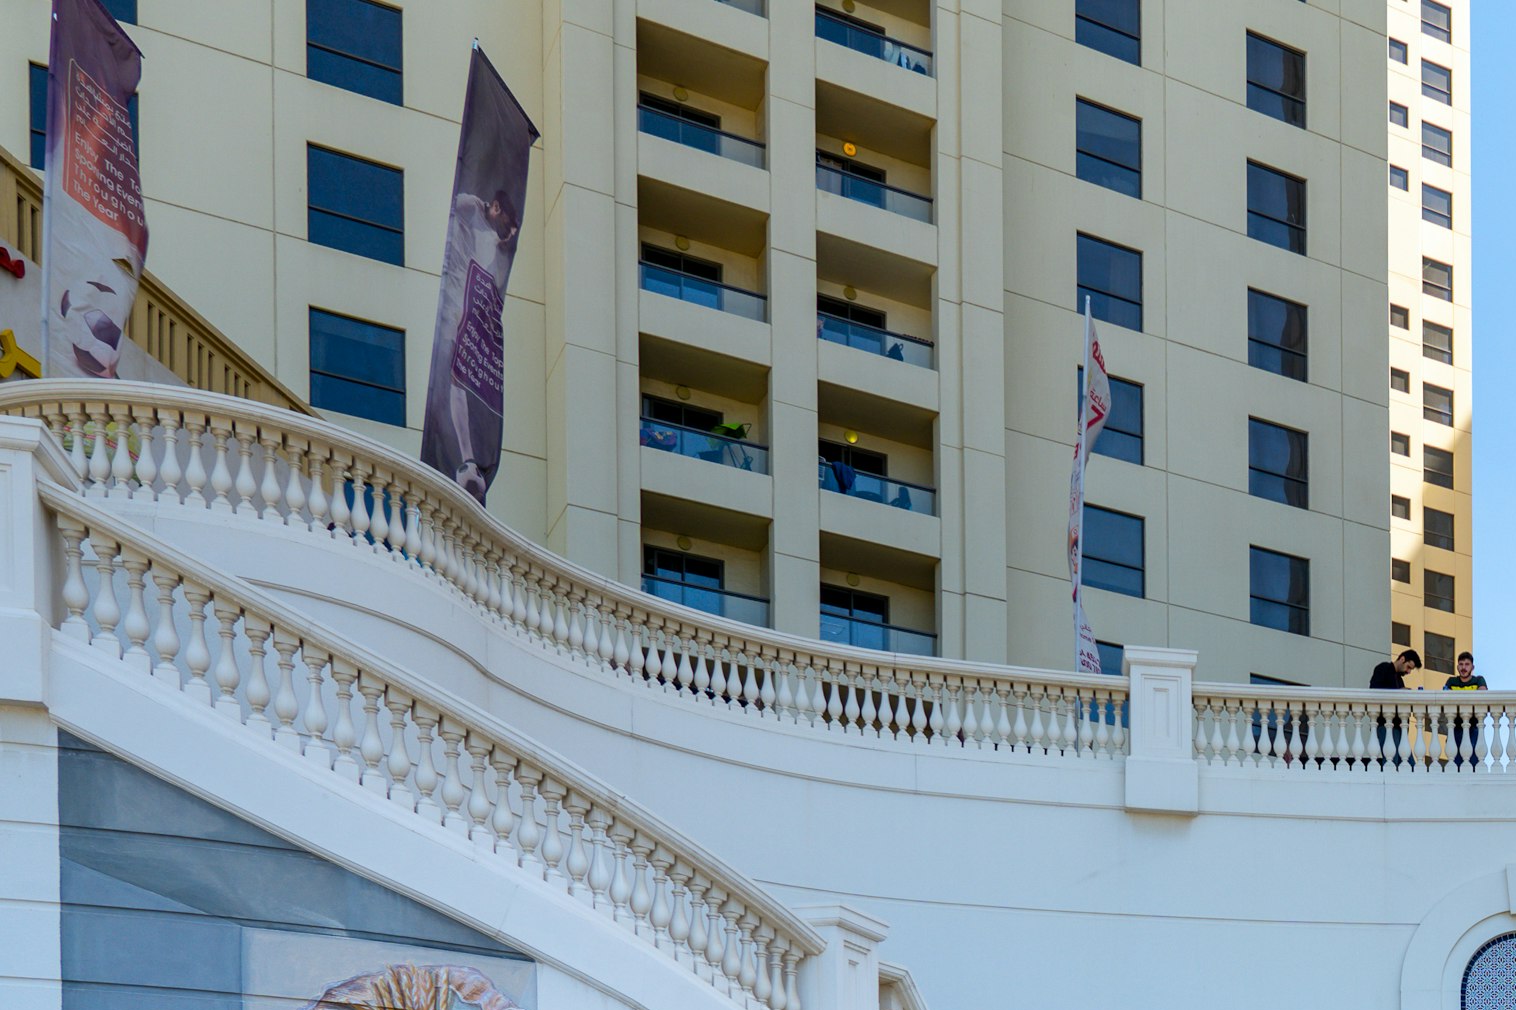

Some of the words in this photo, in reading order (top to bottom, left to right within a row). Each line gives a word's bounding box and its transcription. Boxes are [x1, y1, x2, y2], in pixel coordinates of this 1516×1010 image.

[75, 132, 99, 163] Enjoy
[104, 158, 124, 182] The
[129, 178, 142, 195] To
[73, 179, 91, 202] The
[93, 195, 119, 221] Year
[74, 163, 143, 227] Throughou
[116, 183, 143, 212] Even
